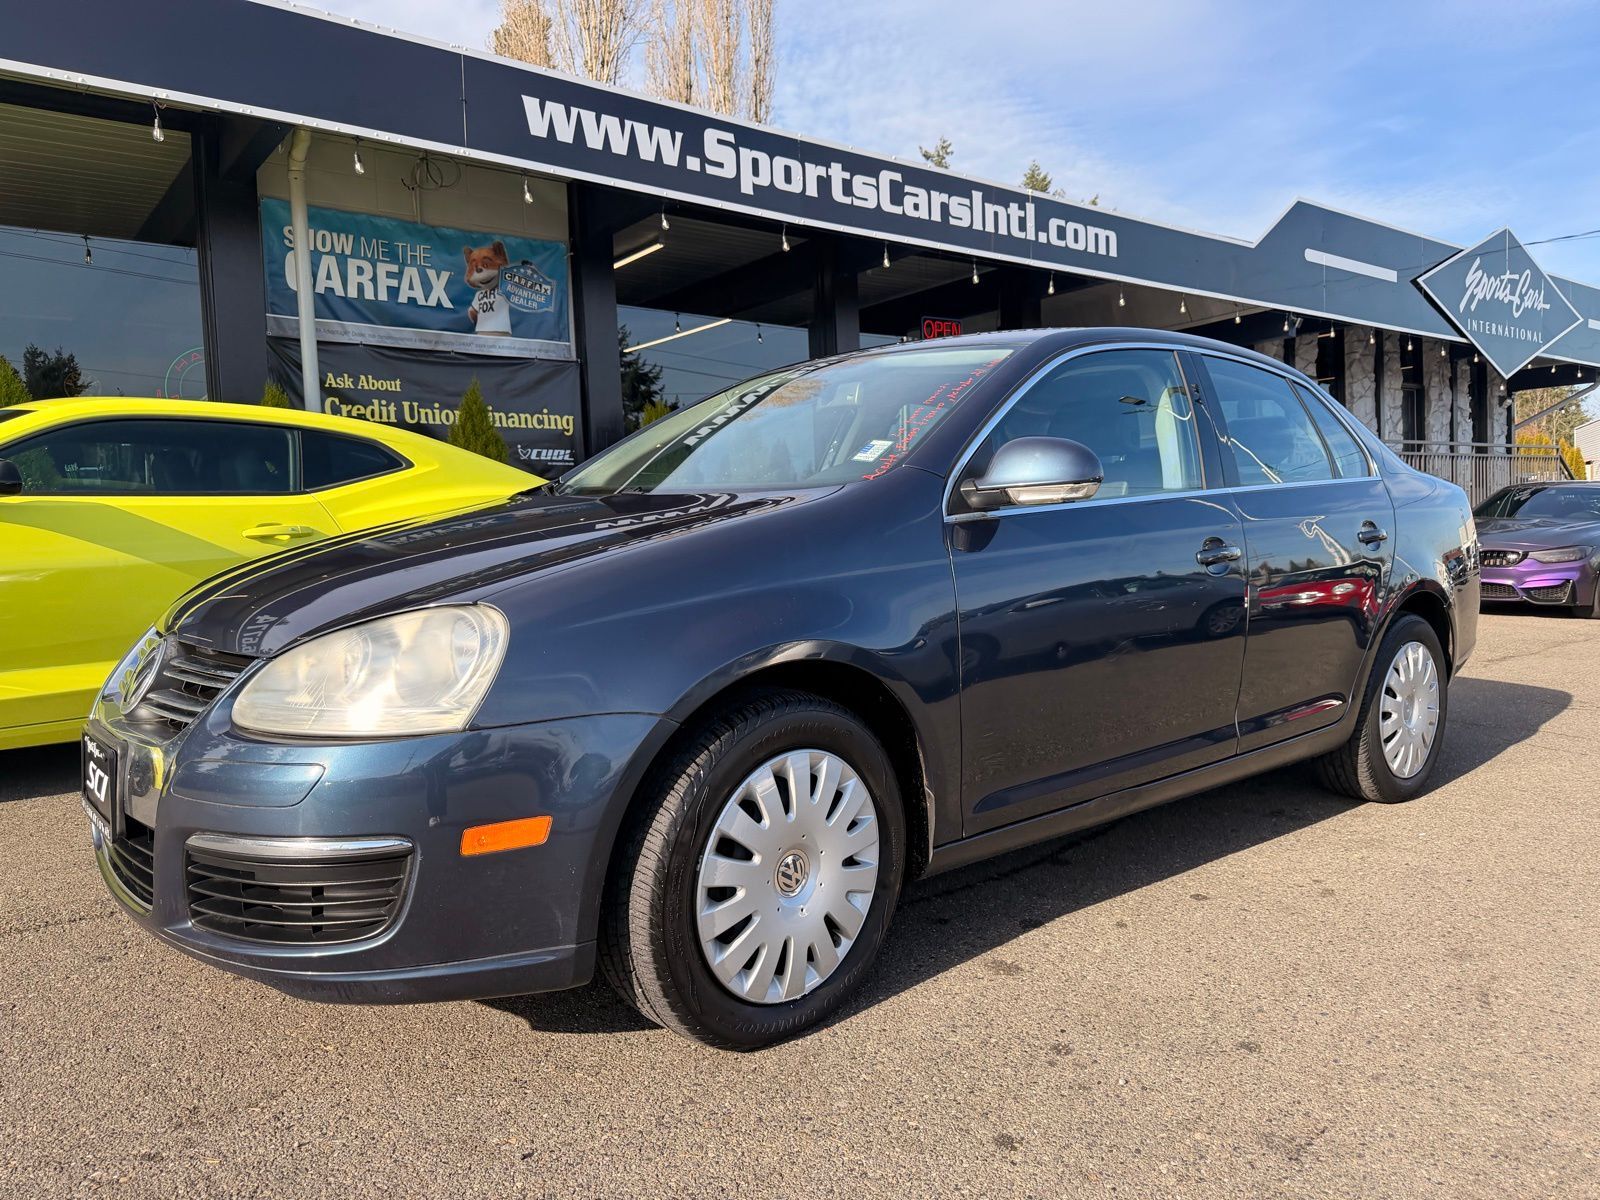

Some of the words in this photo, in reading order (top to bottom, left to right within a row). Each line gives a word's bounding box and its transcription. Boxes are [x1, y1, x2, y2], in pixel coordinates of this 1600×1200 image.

[521, 95, 1118, 257] www.SportsCarsIntl.com
[361, 236, 391, 261] ME
[394, 242, 432, 267] THE
[477, 289, 497, 301] CAR
[504, 272, 553, 296] CARFAX
[506, 284, 547, 304] ADVANTAGE
[1459, 257, 1519, 314] Sports
[1512, 269, 1551, 319] Cars
[478, 301, 496, 313] FOX
[510, 294, 538, 310] DEALER
[923, 319, 961, 339] OPEN
[1467, 318, 1544, 344] INTERNATIONAL
[324, 373, 353, 389] Ask
[358, 374, 401, 392] About
[324, 397, 398, 423] Credit
[487, 406, 575, 437] inancing
